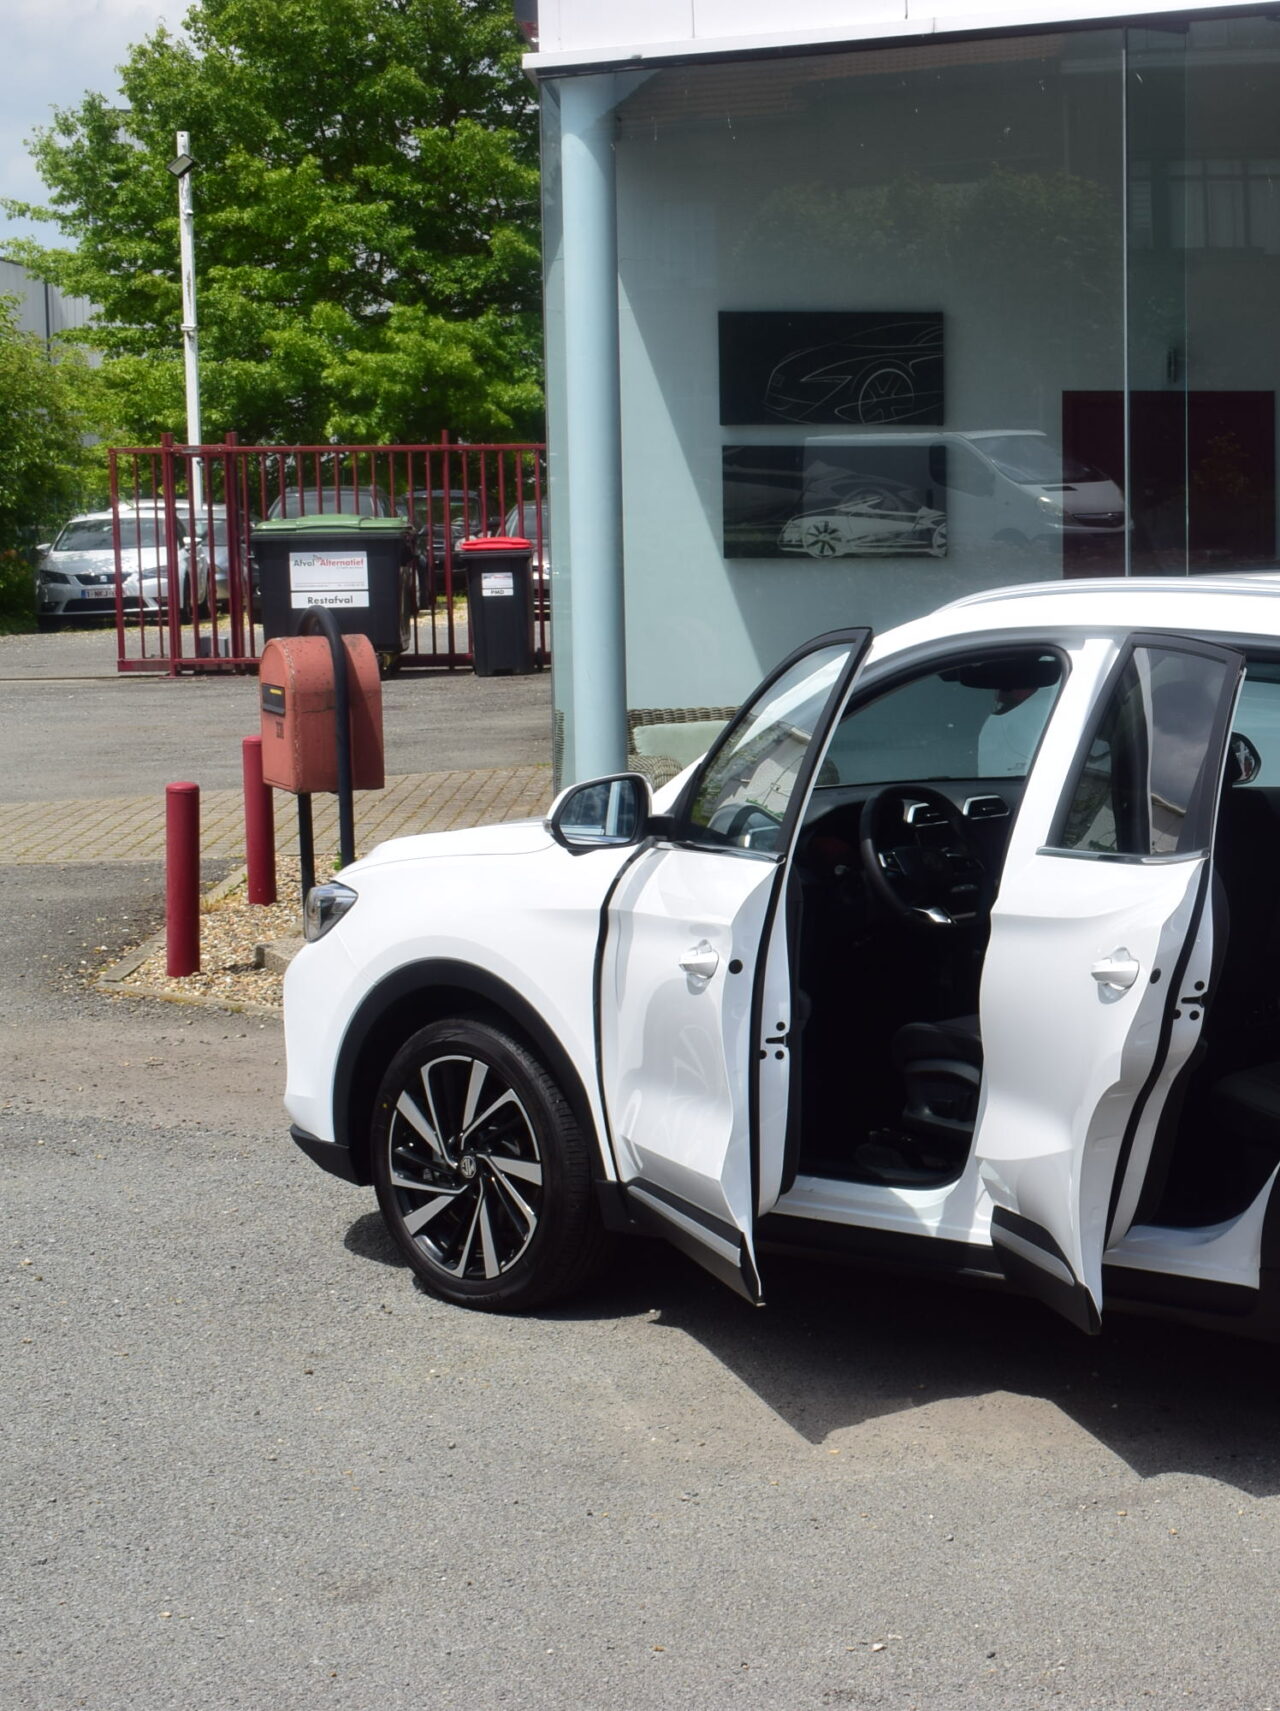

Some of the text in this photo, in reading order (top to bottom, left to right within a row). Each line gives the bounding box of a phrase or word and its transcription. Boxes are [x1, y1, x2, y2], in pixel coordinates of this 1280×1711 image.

[293, 558, 364, 567] Afval Alternatief
[307, 595, 354, 605] Restafval
